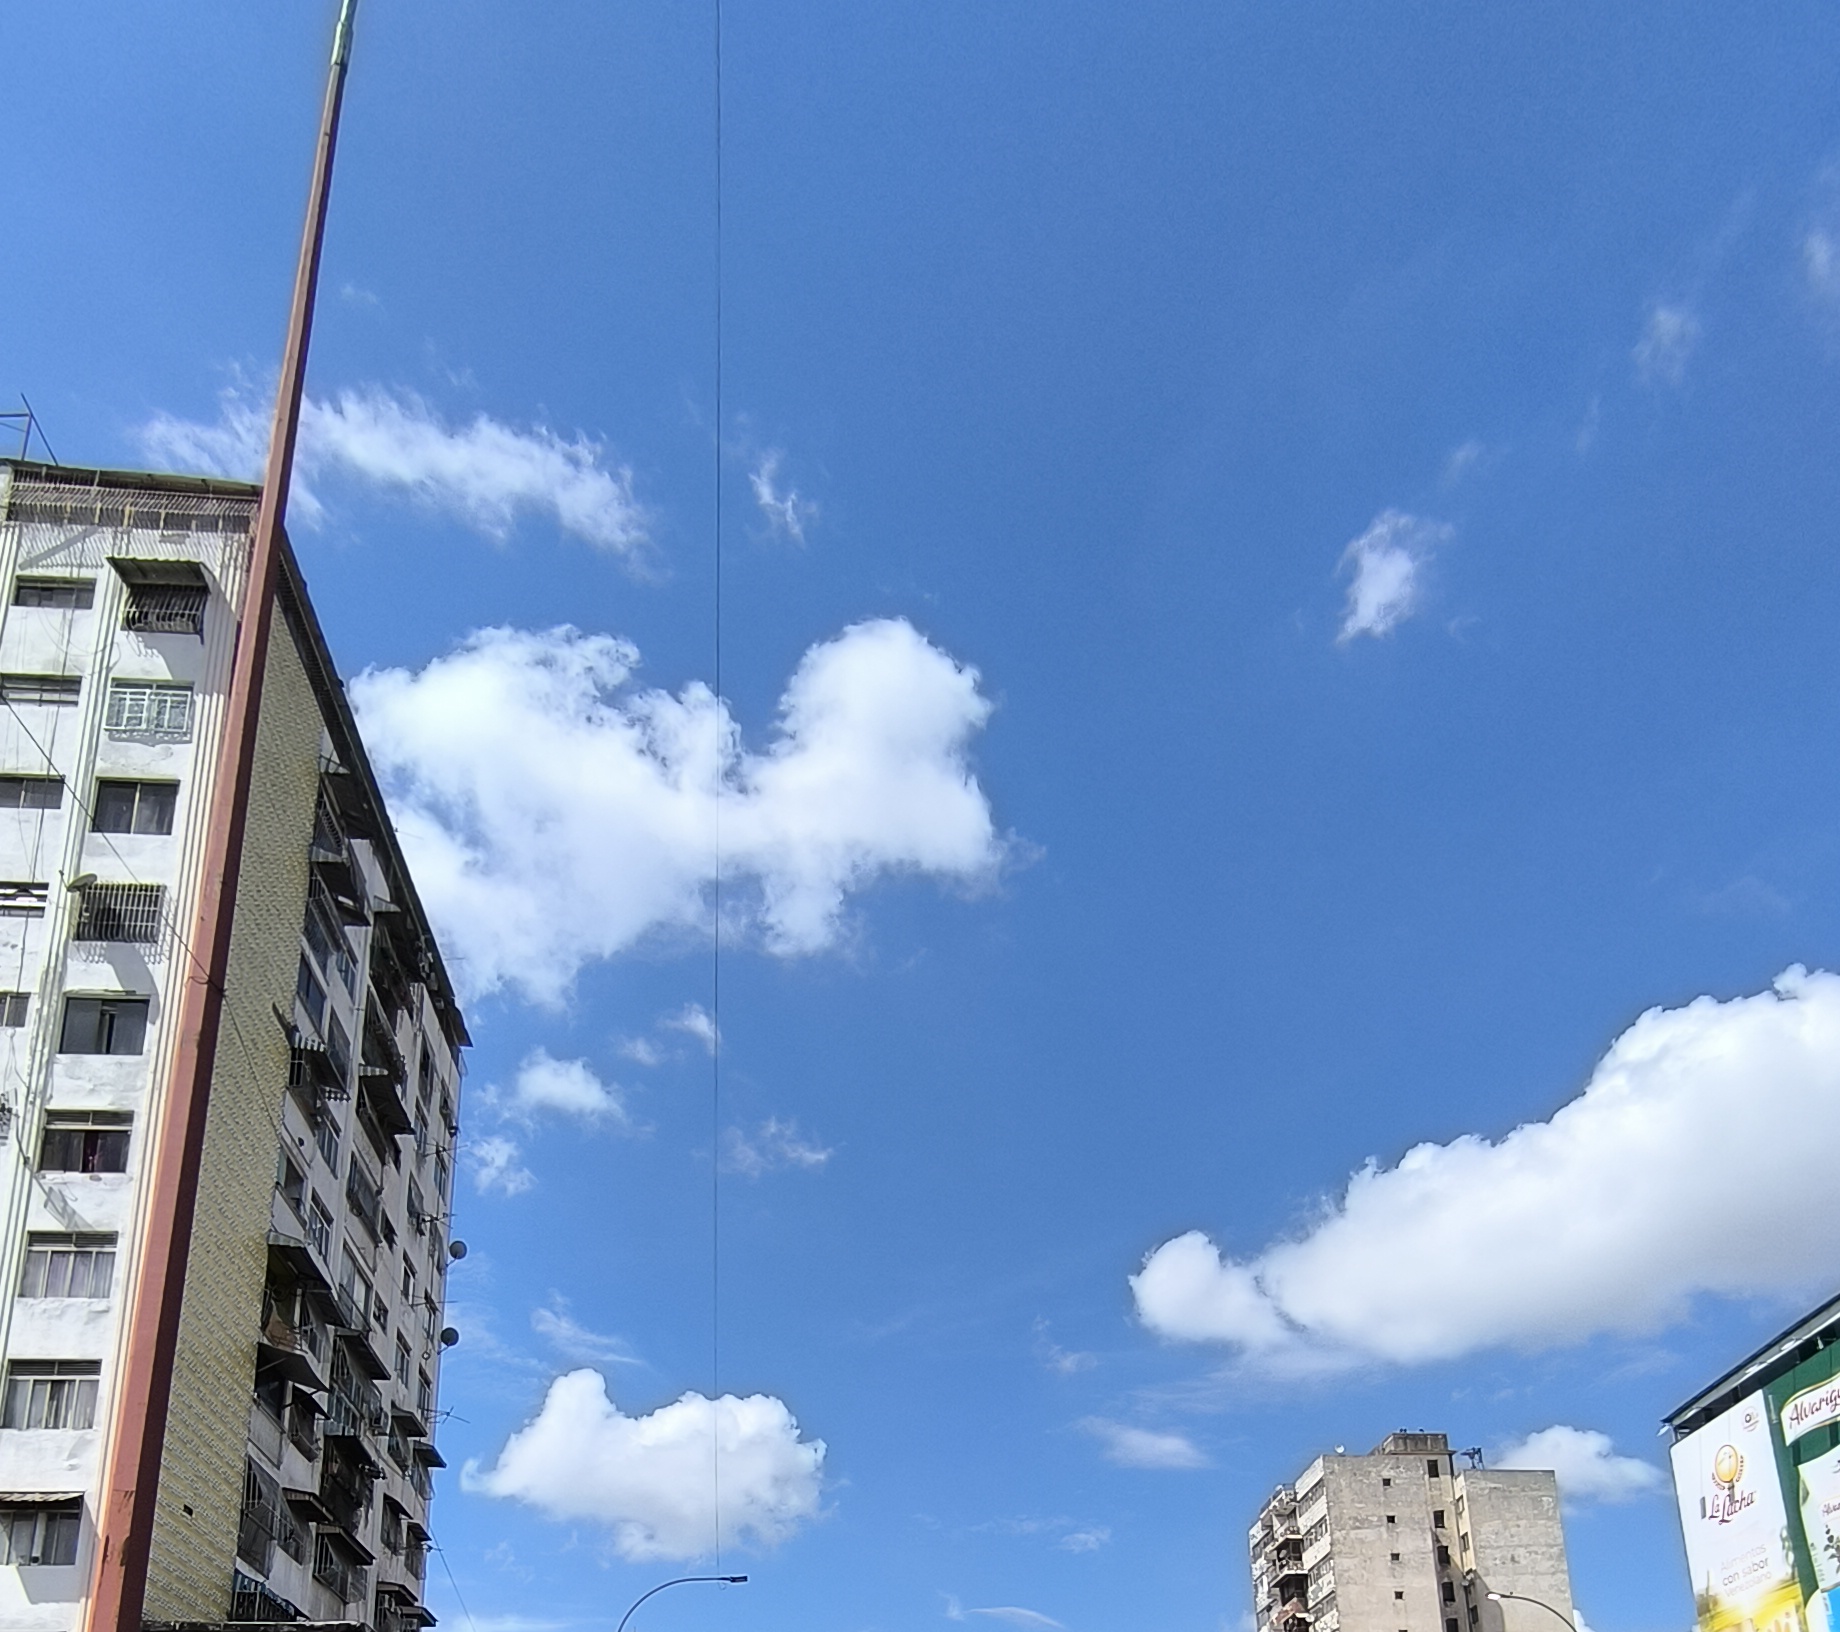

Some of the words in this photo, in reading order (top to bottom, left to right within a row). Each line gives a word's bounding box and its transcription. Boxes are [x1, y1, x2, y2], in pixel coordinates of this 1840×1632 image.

[1708, 1494, 1720, 1520] La
[1718, 1489, 1754, 1525] Lacha
[1721, 1544, 1767, 1571] Alimentos
[1722, 1572, 1740, 1587] con
[1742, 1557, 1769, 1578] sabor
